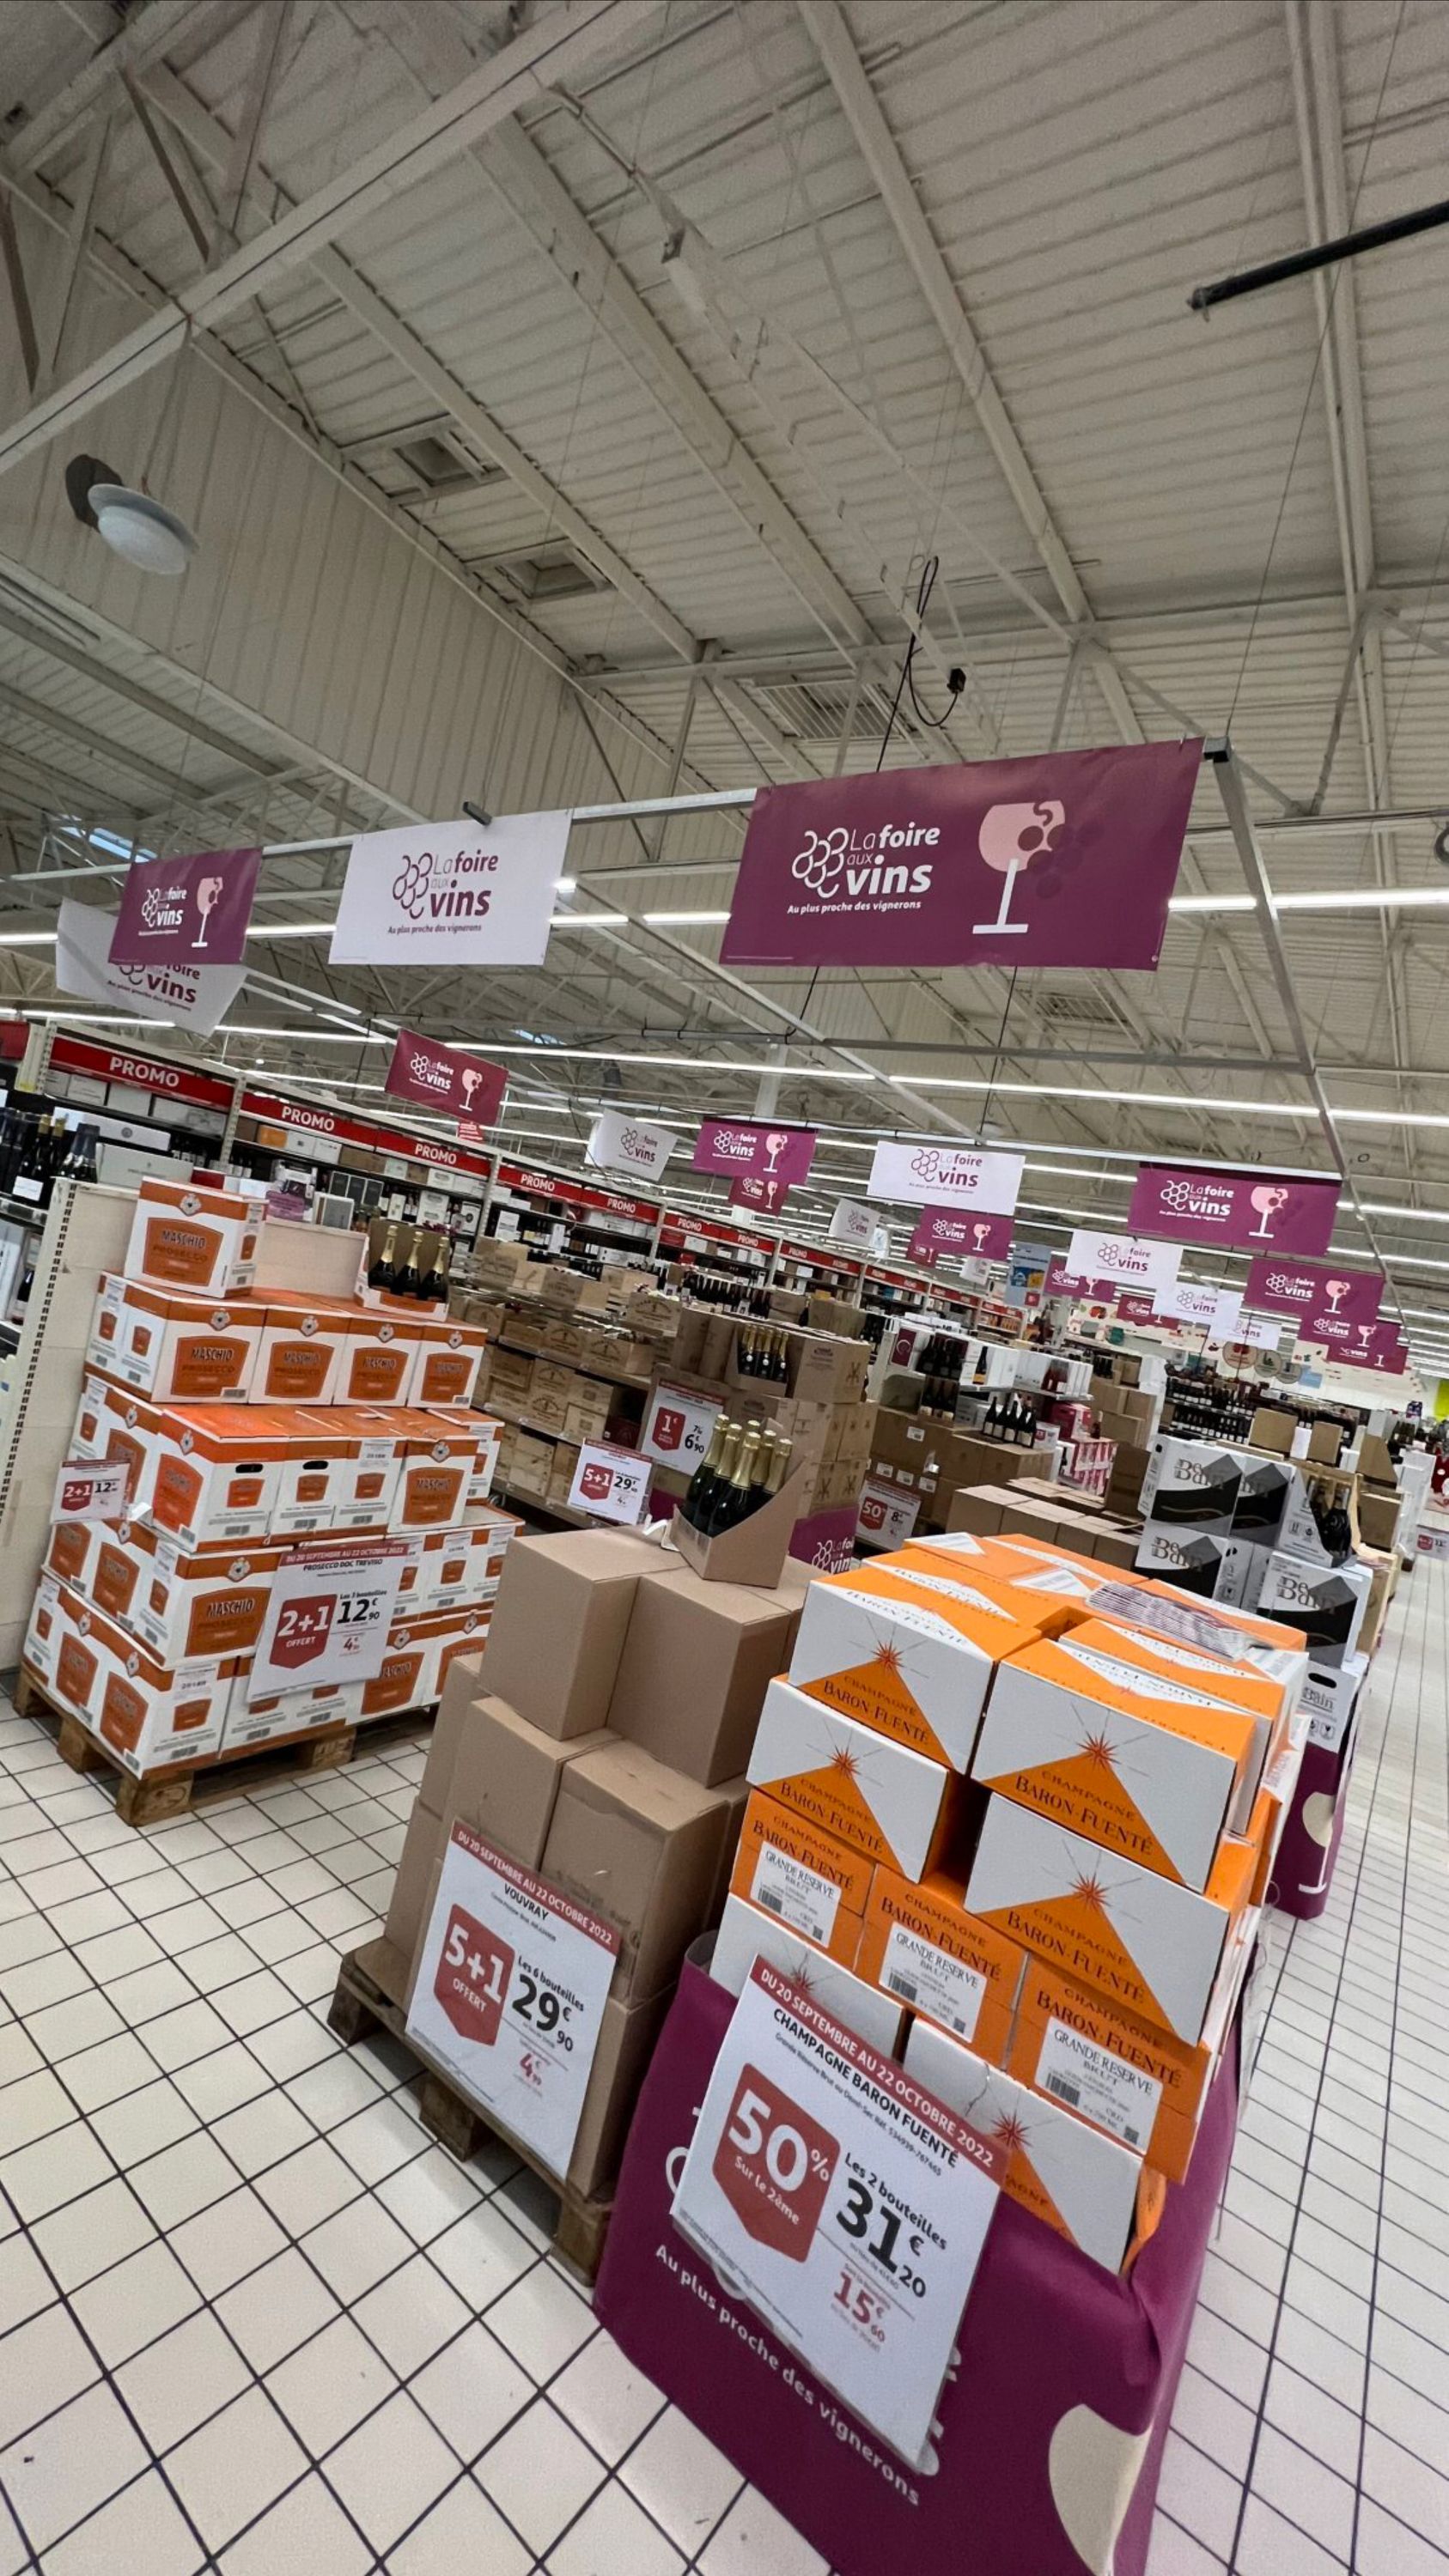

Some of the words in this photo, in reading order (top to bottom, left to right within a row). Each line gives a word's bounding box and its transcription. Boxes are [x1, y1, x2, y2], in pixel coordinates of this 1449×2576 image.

[850, 829, 875, 851] La
[880, 822, 941, 848] foire
[455, 849, 498, 872] foire
[847, 854, 874, 866] aux
[846, 854, 933, 895] vins
[167, 886, 187, 901] foire
[430, 879, 491, 917] vins
[156, 904, 183, 926] vins
[788, 905, 799, 914] Au
[801, 903, 819, 914] plus
[821, 902, 852, 914] proche
[855, 902, 870, 910] des
[873, 901, 921, 912] vignerons
[148, 973, 198, 1003] vins
[110, 1056, 180, 1088] PROMO
[426, 1072, 452, 1090] vins
[282, 1105, 335, 1133] PROMO
[414, 1143, 457, 1164] PROMO
[729, 1143, 755, 1157] vins
[953, 1154, 983, 1167] foire
[521, 1173, 555, 1192] PROMO
[938, 1167, 978, 1187] vins
[1204, 1186, 1234, 1199] foire
[606, 1197, 636, 1215] PROMO
[1189, 1197, 1231, 1216] vins
[678, 1218, 702, 1232] PROMO
[162, 1230, 205, 1248] MASCHIO
[737, 1235, 758, 1248] PROMO
[1118, 1256, 1148, 1272] vins
[1283, 1285, 1313, 1298] vins
[1192, 1303, 1216, 1313] vins
[192, 1347, 234, 1361] MASCHIO
[584, 1468, 610, 1487] 5+1
[614, 1476, 631, 1490] 29
[64, 1485, 90, 1498] 2+1
[862, 1502, 880, 1517] 50
[303, 1561, 339, 1571] PROSECCO
[831, 1554, 852, 1573] vin
[206, 1599, 254, 1618] MASCHIO
[277, 1606, 330, 1637] 2+1
[337, 1598, 369, 1624] 12
[368, 1612, 380, 1620] 90
[286, 1636, 316, 1648] OFFERT
[801, 1778, 871, 1823] CHAMPAGNE
[1042, 1771, 1135, 1821] CHAMPAGNE
[773, 1816, 843, 1860] CHAMPAGNE
[765, 1850, 797, 1879] GRANDE
[458, 1831, 469, 1844] DU
[471, 1838, 479, 1851] 20
[479, 1846, 524, 1884] SEPTEMBRE
[523, 1879, 536, 1892] AU
[536, 1886, 547, 1901] 22
[547, 1894, 588, 1928] OCTOBRE
[588, 1921, 612, 1945] 2022
[504, 1883, 549, 1920] VOUVRAY
[904, 1893, 988, 1947] CHAMPAGNE
[896, 1933, 935, 1960] GRANDE
[1034, 1908, 1128, 1965] CHAMPAGNE
[445, 1923, 503, 2003] 5+1
[518, 1955, 532, 1973] Les
[533, 1968, 539, 1978] 6
[540, 1971, 584, 2012] bouteilles
[452, 1978, 487, 2013] OFFERT
[512, 1974, 559, 2032] 29
[1064, 1988, 1160, 2047] CHAMPAGNE
[557, 2030, 574, 2052] 90
[761, 1968, 776, 1989] DU
[777, 1982, 792, 2002] 20
[792, 1995, 858, 2057] SEPTEMBRE
[857, 2049, 877, 2071] AU
[876, 2063, 895, 2087] 22
[895, 2079, 957, 2136] OCTOBRE
[956, 2127, 994, 2168] 2022
[1054, 2029, 1101, 2063] GRANDE
[1102, 2057, 1154, 2096] RESERVE
[774, 2008, 849, 2080] CHAMPAGNE
[852, 2070, 901, 2120] BARON
[901, 2114, 958, 2168] FUENTÉ
[820, 2069, 834, 2087] Brut
[728, 2089, 808, 2191] 50
[734, 2156, 754, 2183] Sur
[754, 2175, 767, 2193] le
[767, 2190, 800, 2226] 2ème
[844, 2152, 866, 2182] Les
[867, 2170, 878, 2189] 2
[879, 2175, 948, 2251] bouteilles
[835, 2178, 901, 2274] 31
[899, 2264, 926, 2298] 20
[834, 2271, 874, 2324] 15
[655, 2244, 679, 2273] Au
[680, 2269, 715, 2310] plus
[719, 2306, 779, 2372] proche
[782, 2368, 814, 2406] des
[819, 2403, 920, 2507] vignerons
